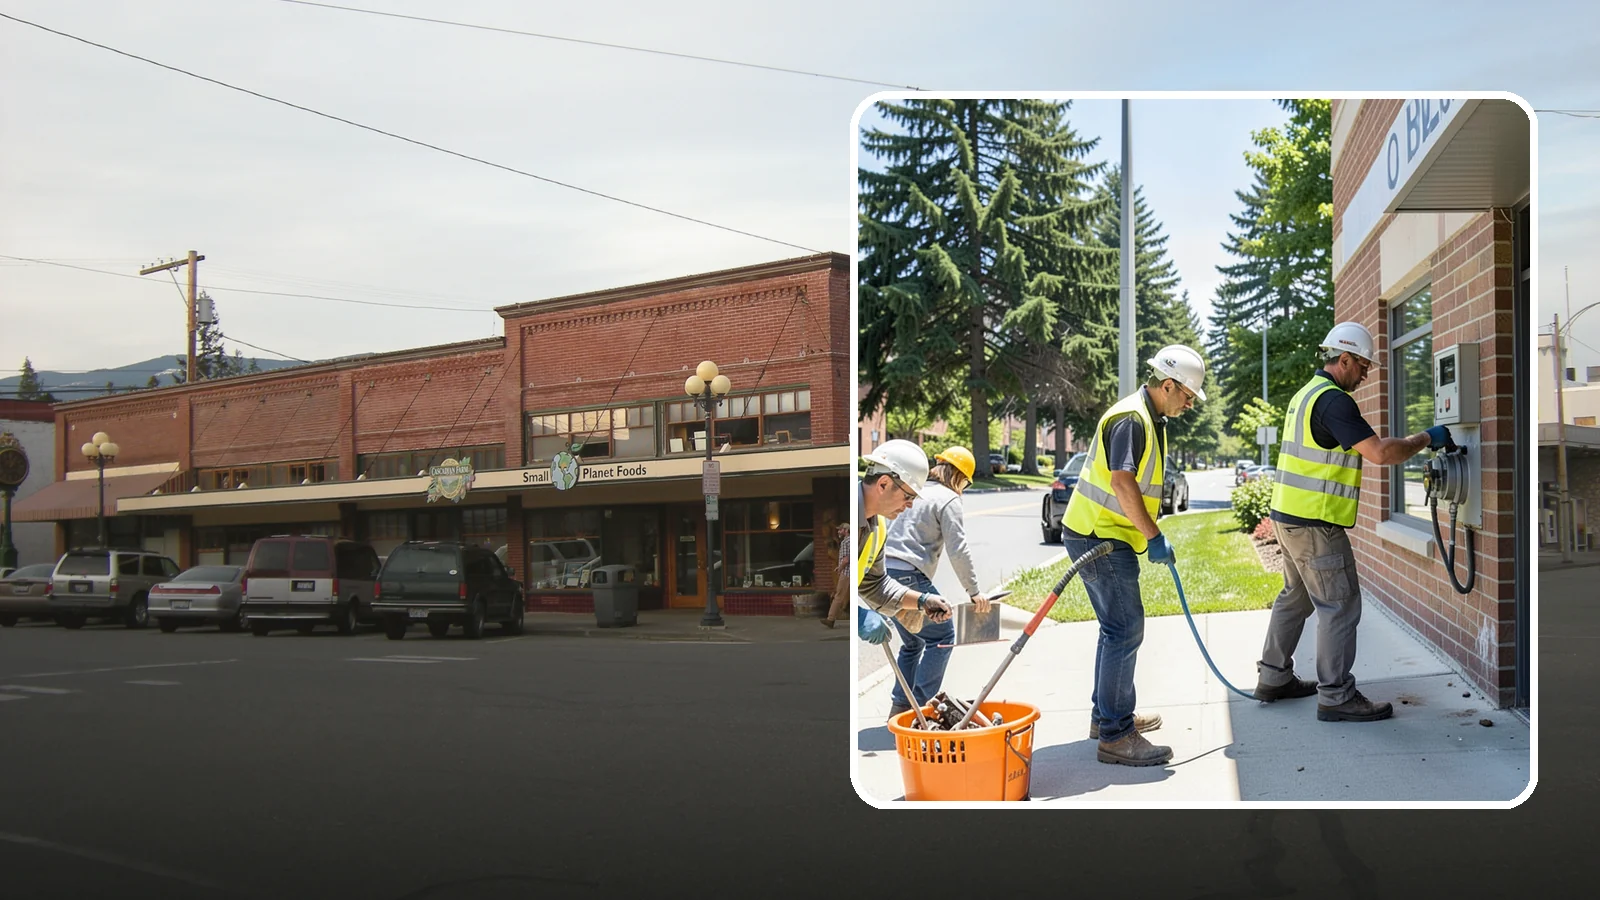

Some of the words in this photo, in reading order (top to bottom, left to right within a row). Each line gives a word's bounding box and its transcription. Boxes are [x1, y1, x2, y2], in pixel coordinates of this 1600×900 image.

[523, 471, 549, 483] Small
[583, 467, 614, 479] Planet
[617, 464, 647, 477] Foods
